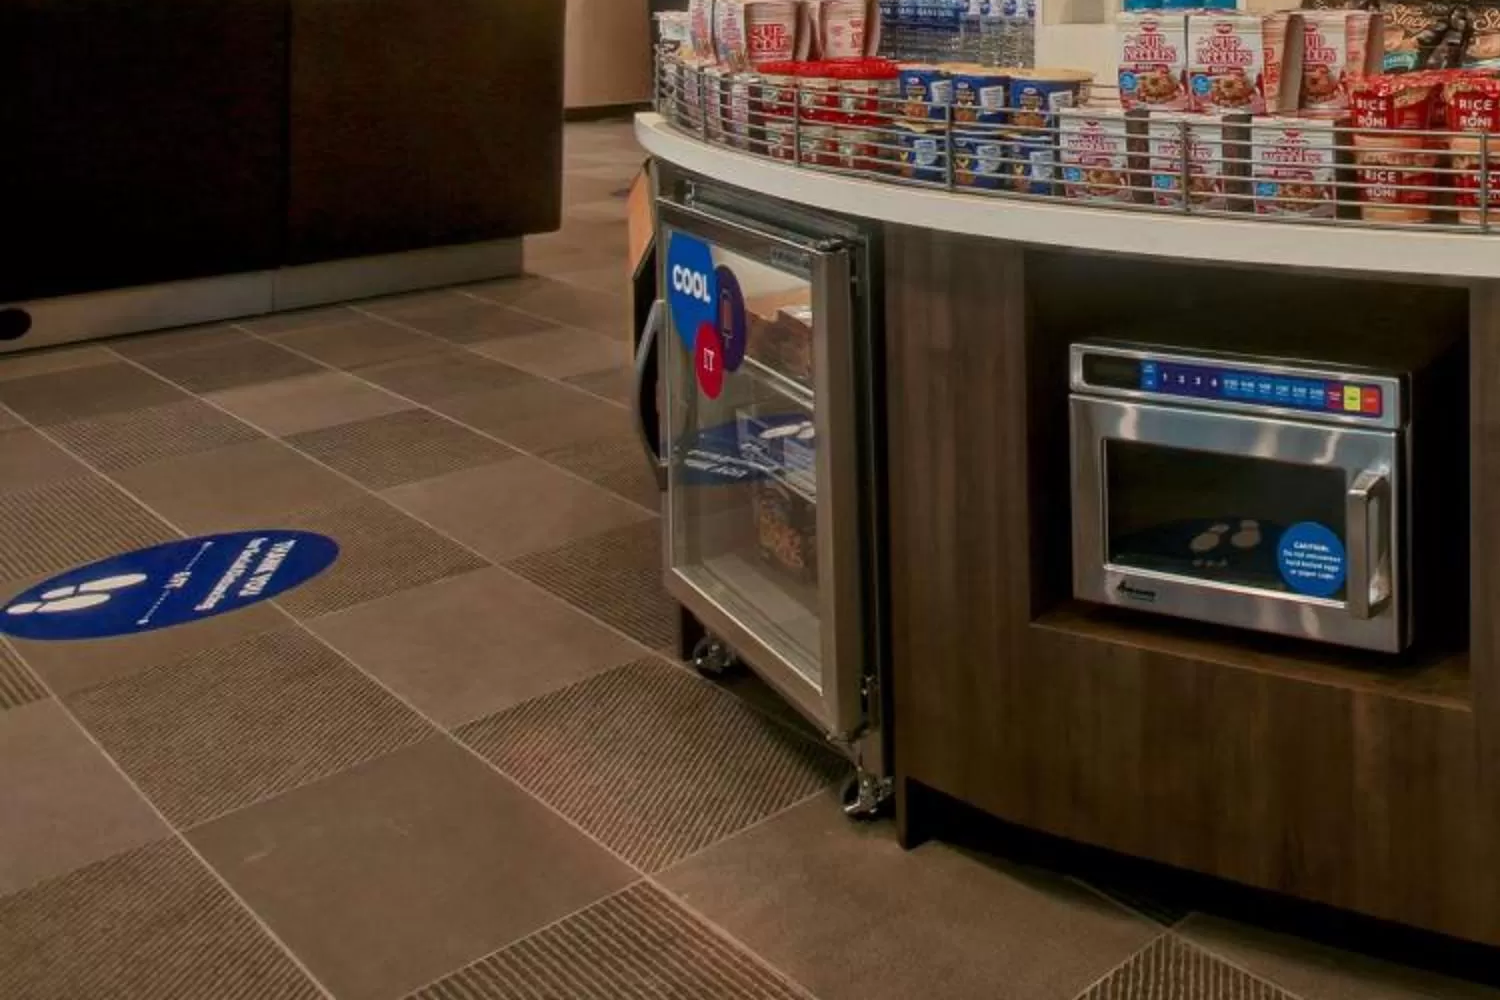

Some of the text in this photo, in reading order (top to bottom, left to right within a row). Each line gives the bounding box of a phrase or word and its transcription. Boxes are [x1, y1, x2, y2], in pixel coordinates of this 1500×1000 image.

[1357, 99, 1388, 111] RICE
[1459, 99, 1493, 111] RICE
[1357, 116, 1388, 128] RONI
[1460, 117, 1493, 128] RONI
[1364, 170, 1397, 181] RICE
[672, 263, 712, 304] COOL
